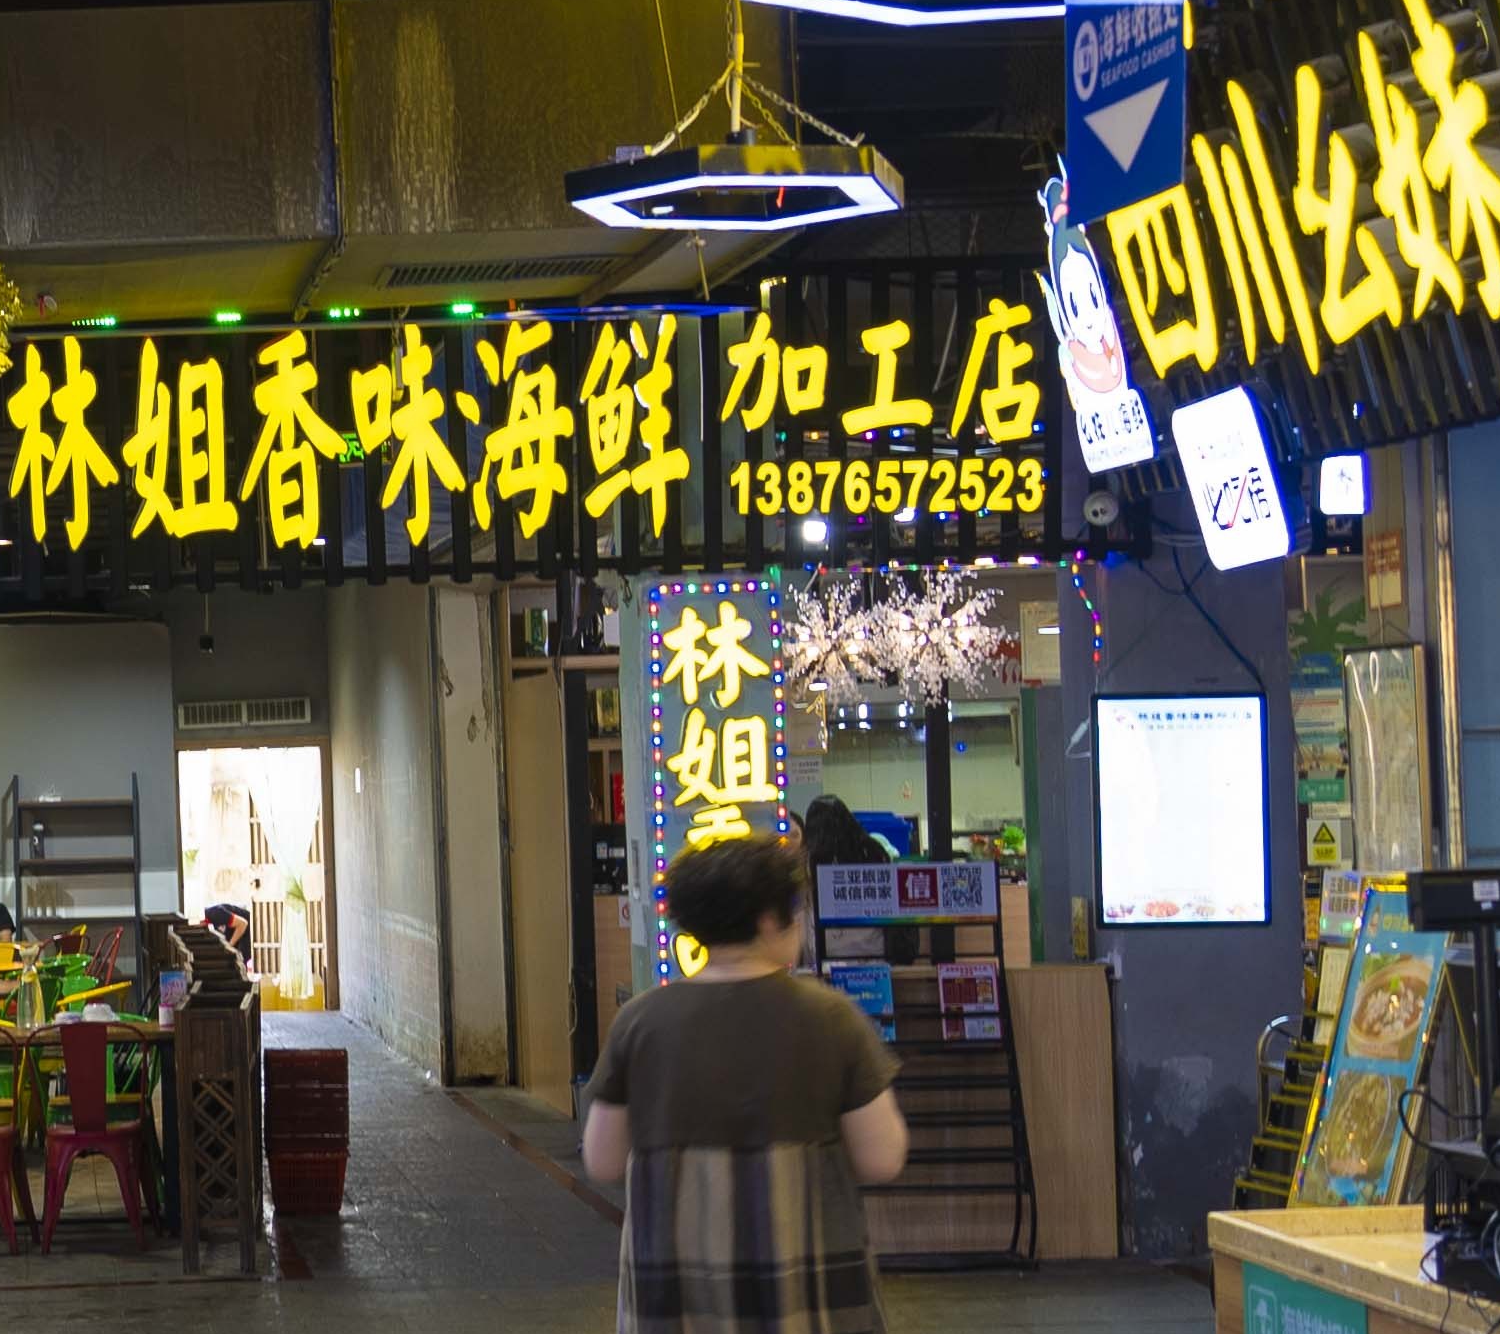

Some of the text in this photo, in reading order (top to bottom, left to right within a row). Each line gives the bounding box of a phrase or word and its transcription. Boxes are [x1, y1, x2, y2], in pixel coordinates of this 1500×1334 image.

[1100, 37, 1177, 88] SEAFOOD CASHIER
[8, 298, 1041, 552] 林姐香味海鲜 加工店
[729, 457, 1045, 518] 13876572523
[905, 872, 931, 899] 信
